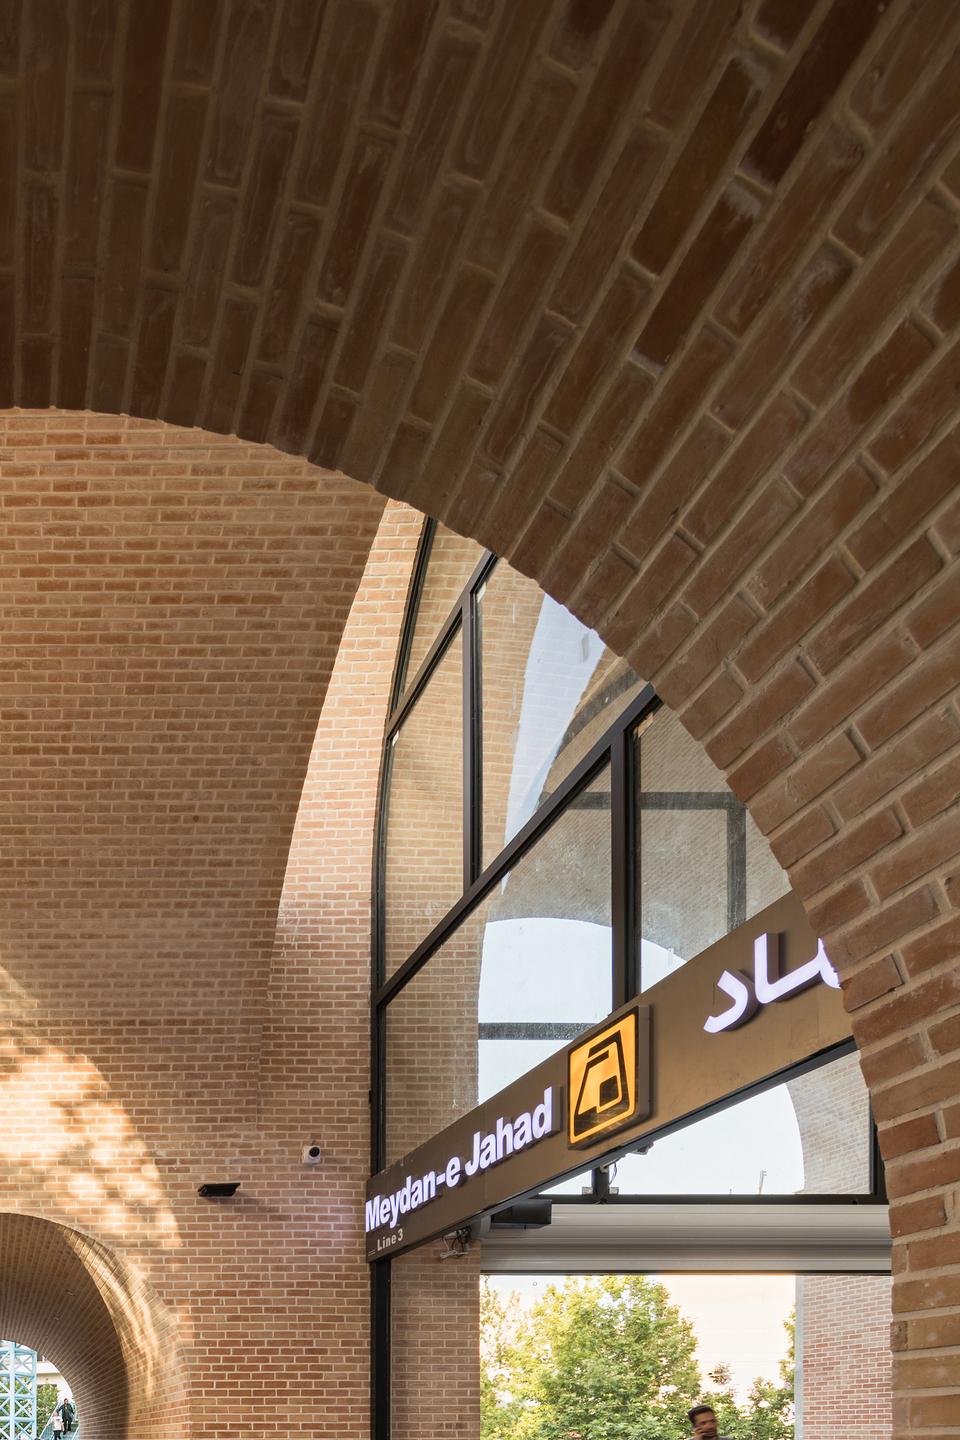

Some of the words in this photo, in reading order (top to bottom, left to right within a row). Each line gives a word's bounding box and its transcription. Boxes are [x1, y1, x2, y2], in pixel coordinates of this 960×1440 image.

[365, 1156, 460, 1232] Meydan-e
[464, 1086, 552, 1176] Jahad
[377, 1235, 397, 1251] Line
[397, 1228, 404, 1242] 3
